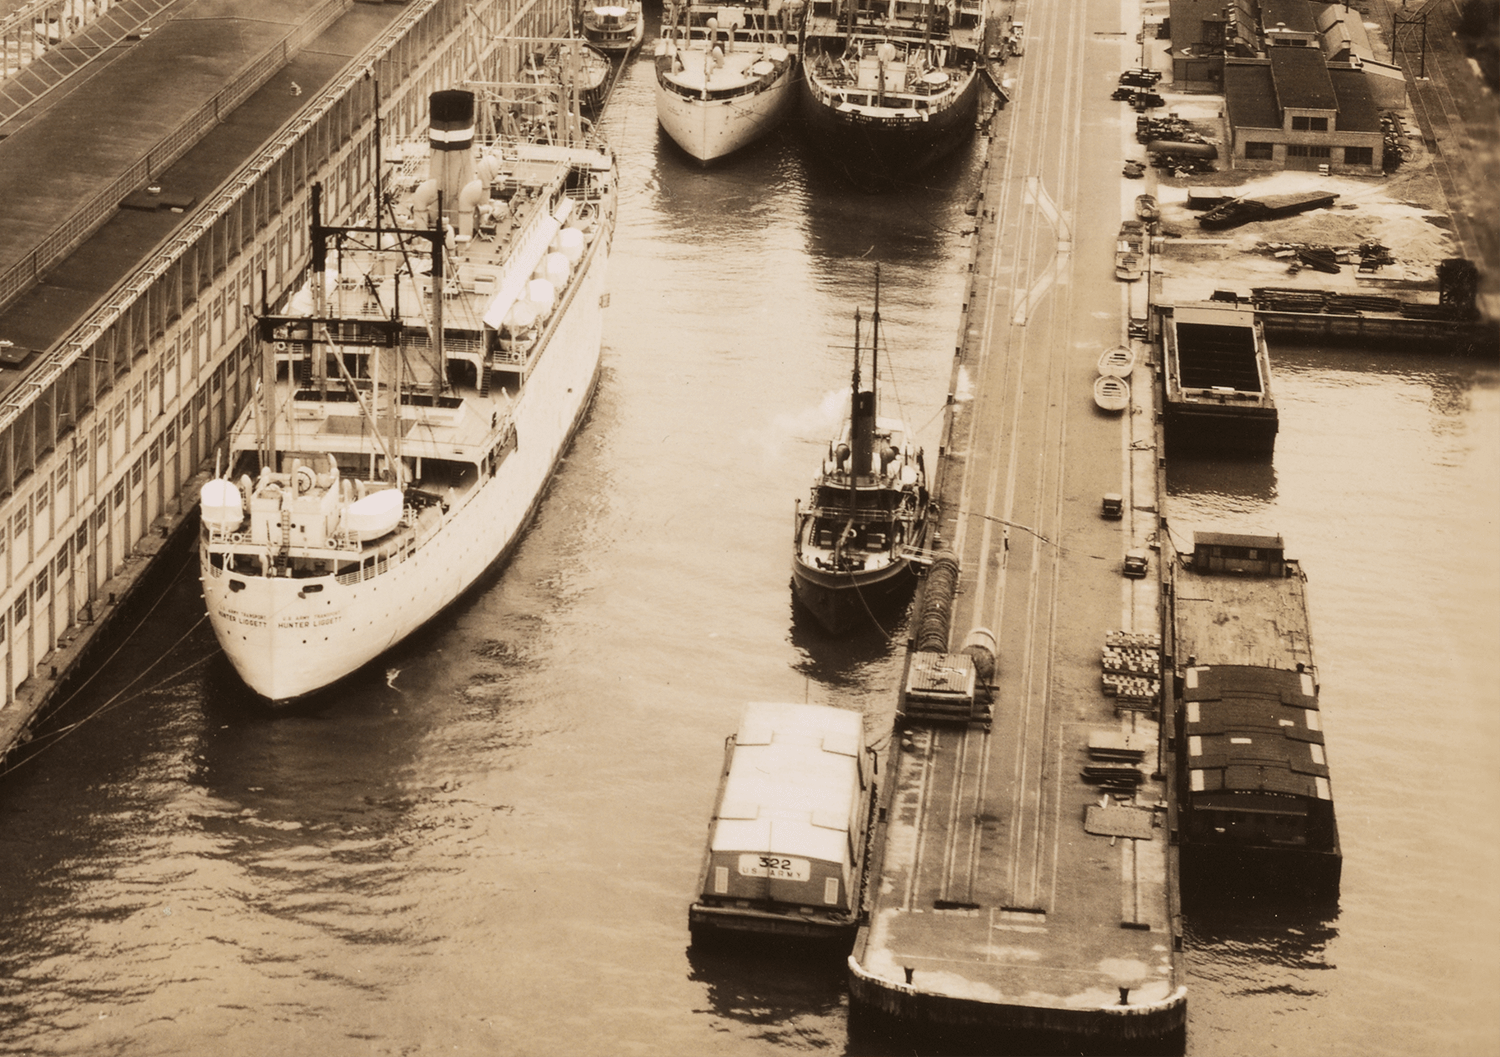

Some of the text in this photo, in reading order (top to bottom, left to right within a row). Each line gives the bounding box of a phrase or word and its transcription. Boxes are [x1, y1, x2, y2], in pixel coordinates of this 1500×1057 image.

[218, 610, 267, 628] HUNTER LIGGETT
[313, 615, 342, 627] LIGGETT
[759, 856, 791, 870] 322
[770, 870, 801, 878] ARMY
